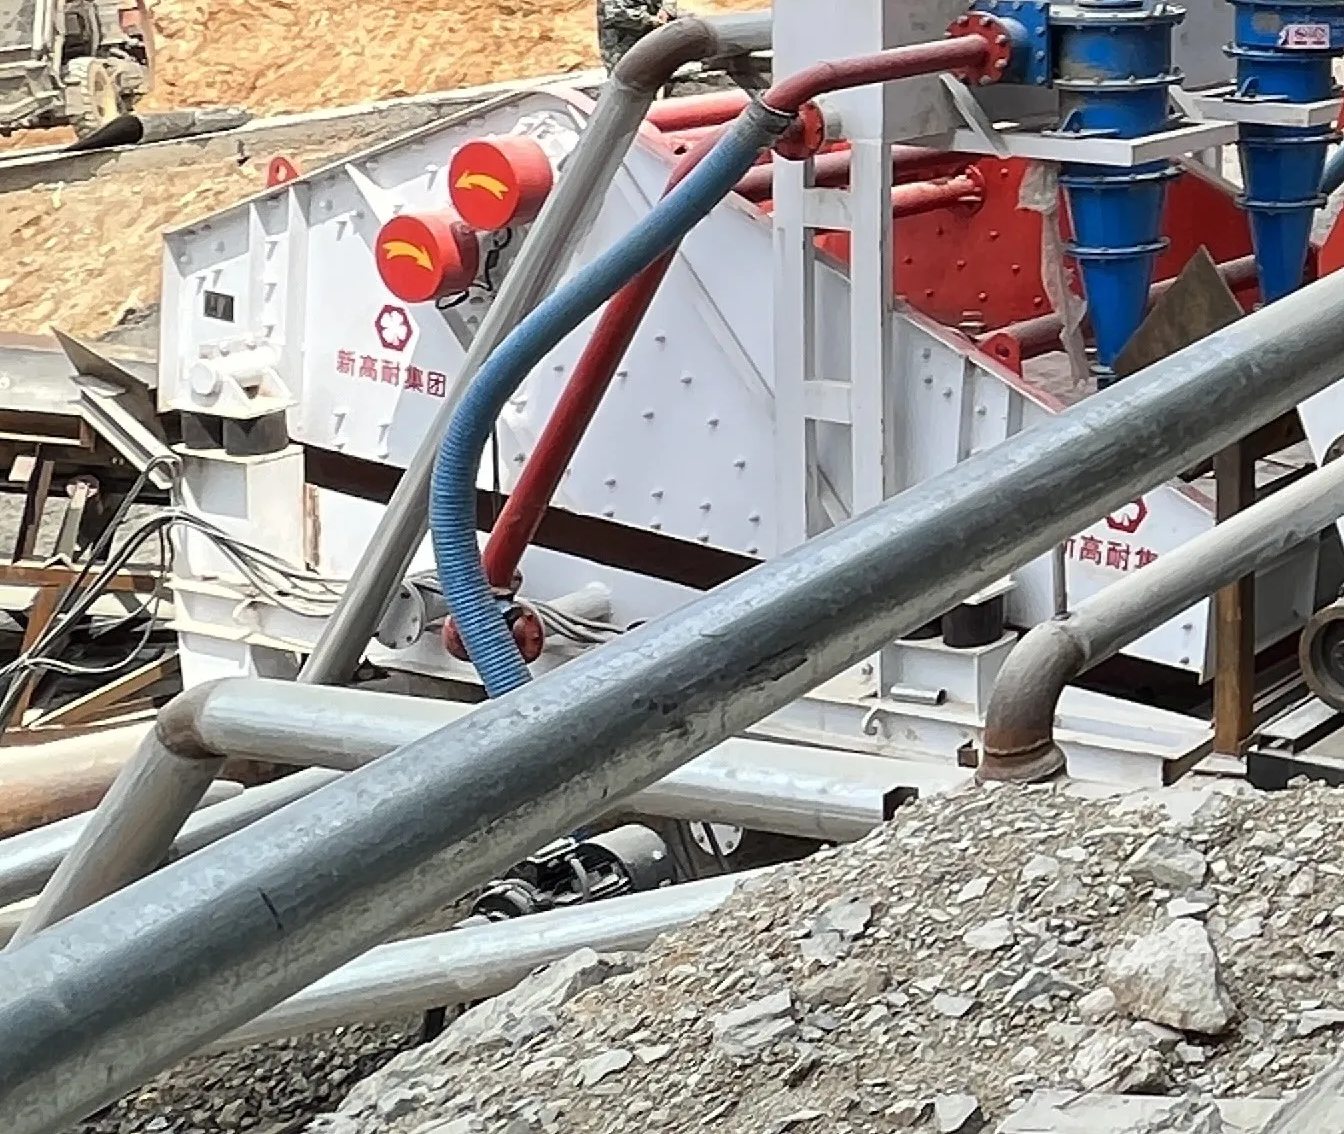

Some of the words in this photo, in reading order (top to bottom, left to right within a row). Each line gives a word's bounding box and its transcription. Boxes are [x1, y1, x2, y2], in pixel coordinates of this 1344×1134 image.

[336, 350, 446, 397] 新高耐集团
